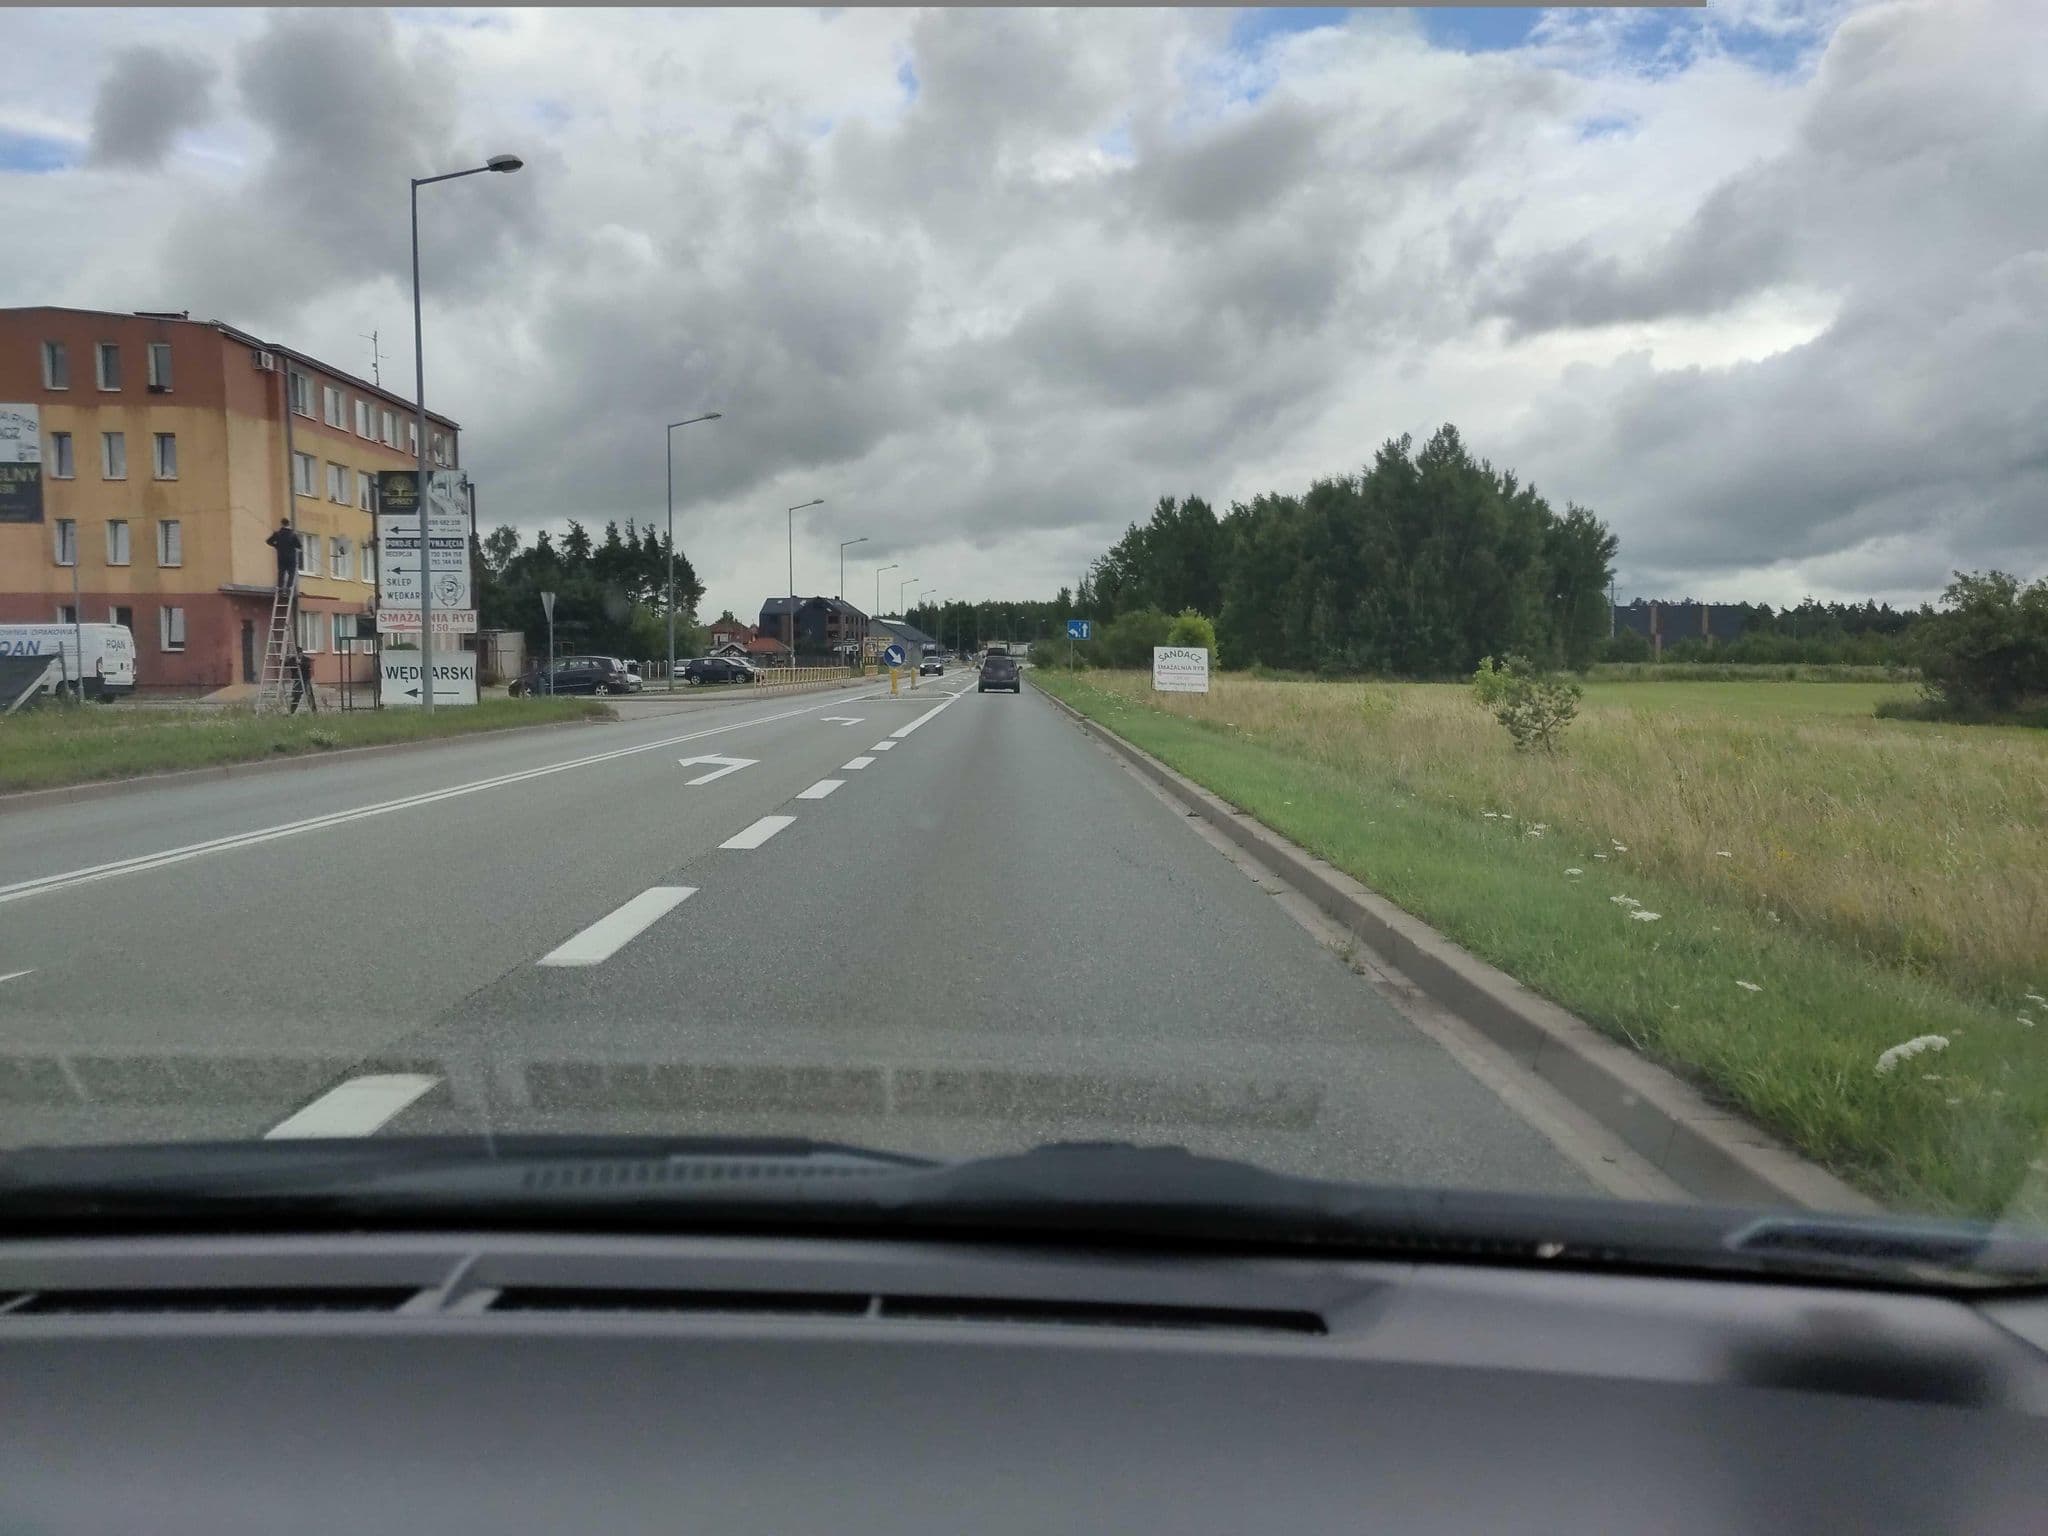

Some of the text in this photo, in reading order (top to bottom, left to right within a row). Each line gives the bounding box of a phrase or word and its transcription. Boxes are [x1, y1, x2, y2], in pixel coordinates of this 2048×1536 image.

[386, 578, 412, 587] SKLEP
[379, 611, 475, 623] SMAŻANIA RYB
[431, 623, 449, 632] 150
[1158, 650, 1202, 664] SANDACZ
[385, 666, 474, 684] WĘDARSKI
